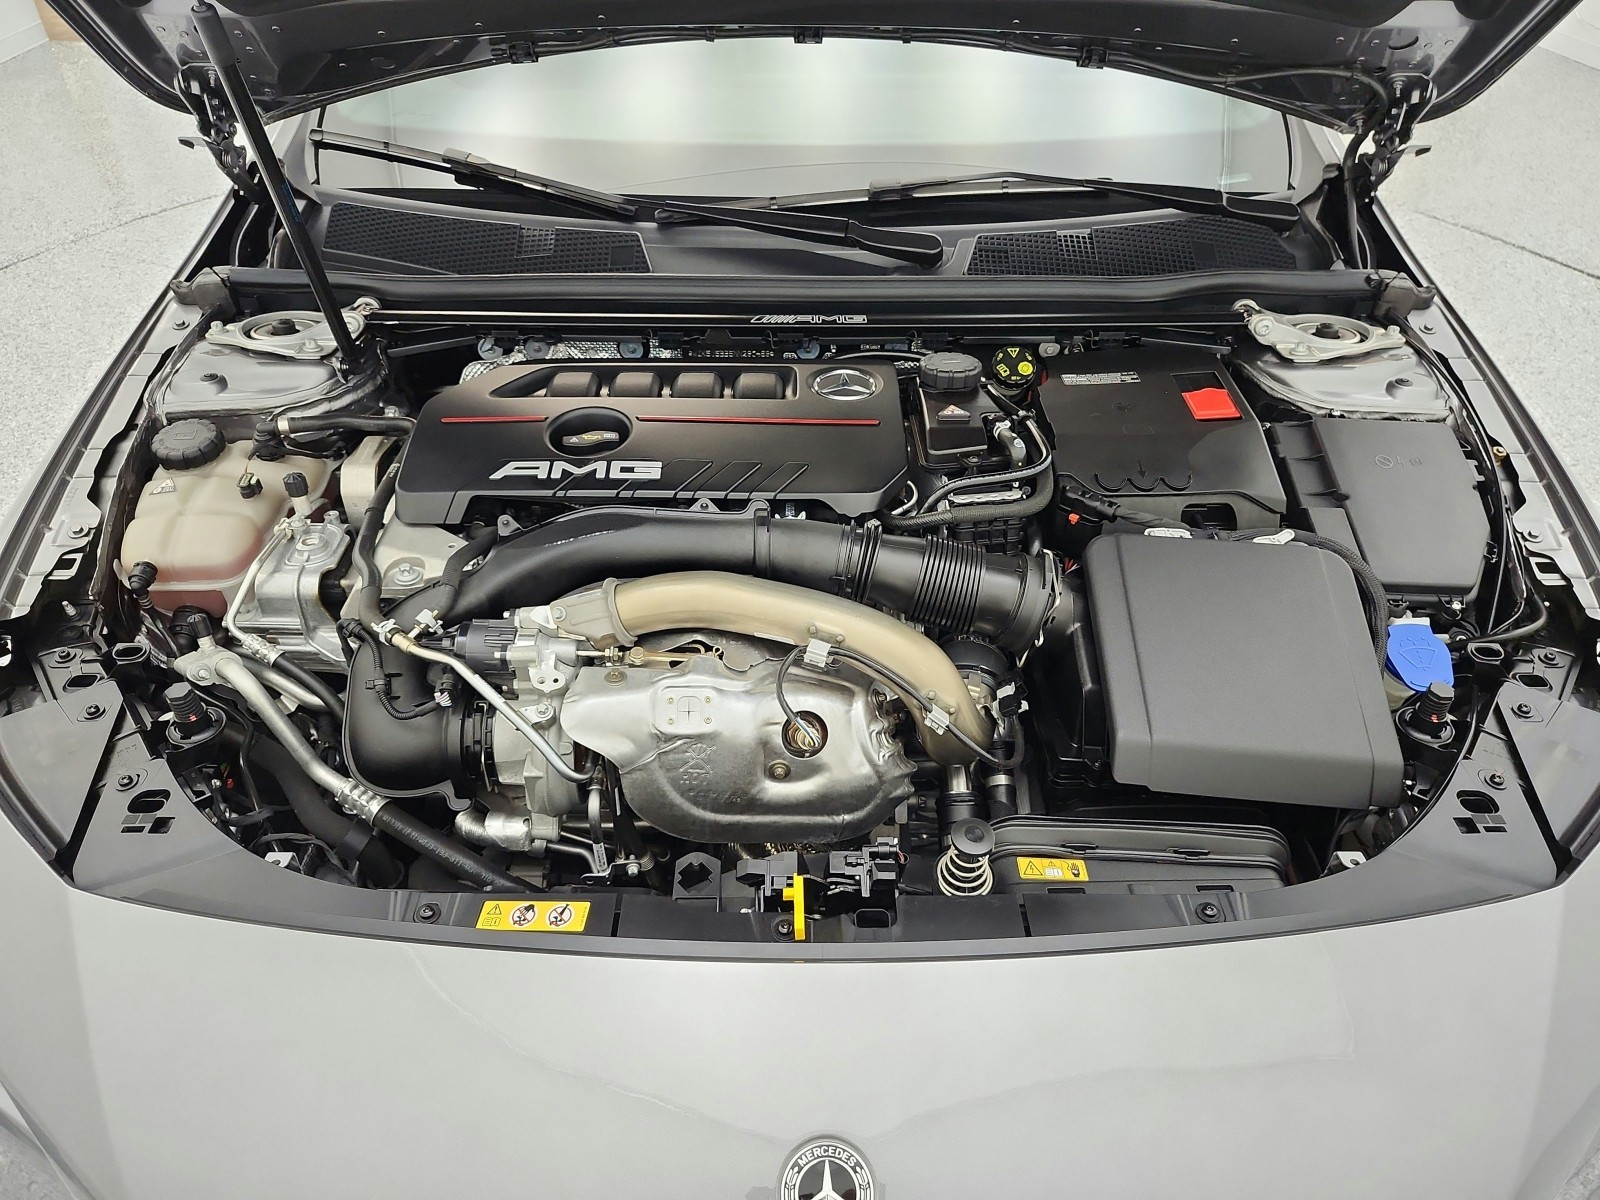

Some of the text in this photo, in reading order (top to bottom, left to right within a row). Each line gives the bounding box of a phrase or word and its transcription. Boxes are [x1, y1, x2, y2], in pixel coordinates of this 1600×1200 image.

[793, 314, 868, 324] AMG
[488, 460, 663, 480] AMG
[797, 1146, 857, 1167] MERCEDES
